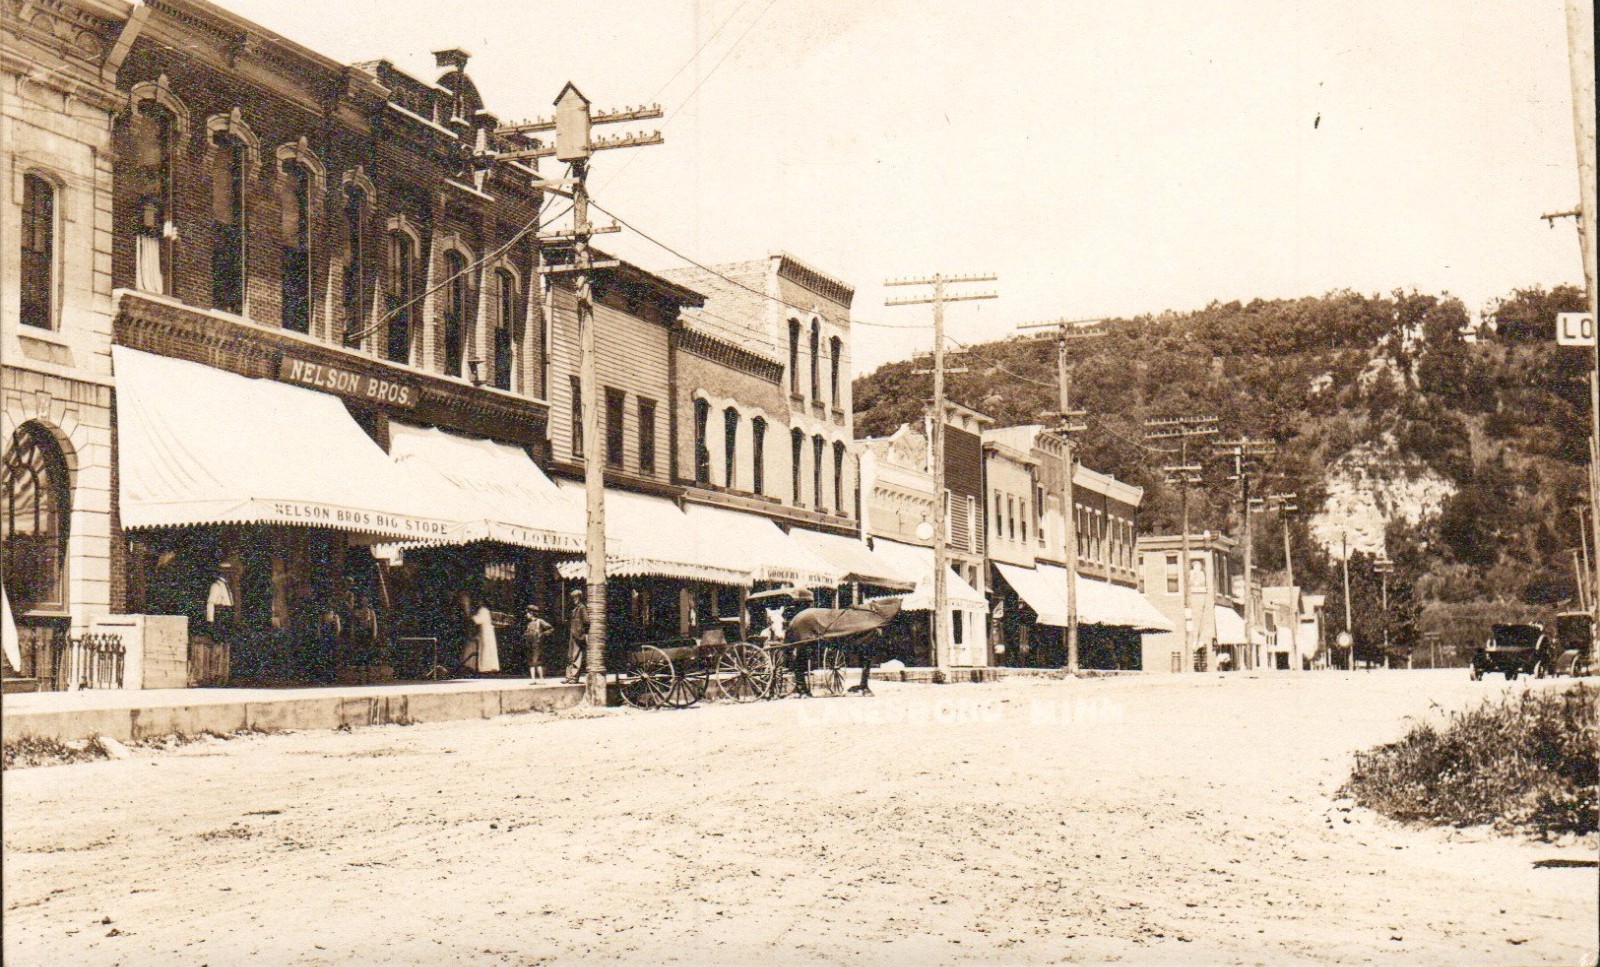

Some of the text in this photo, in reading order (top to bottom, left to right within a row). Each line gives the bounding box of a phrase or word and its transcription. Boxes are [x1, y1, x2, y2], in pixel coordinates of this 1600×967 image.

[290, 359, 412, 405] NELSON BROS.
[275, 503, 448, 535] NELSON BROS BIG STORE
[511, 528, 588, 547] CLOTHIN
